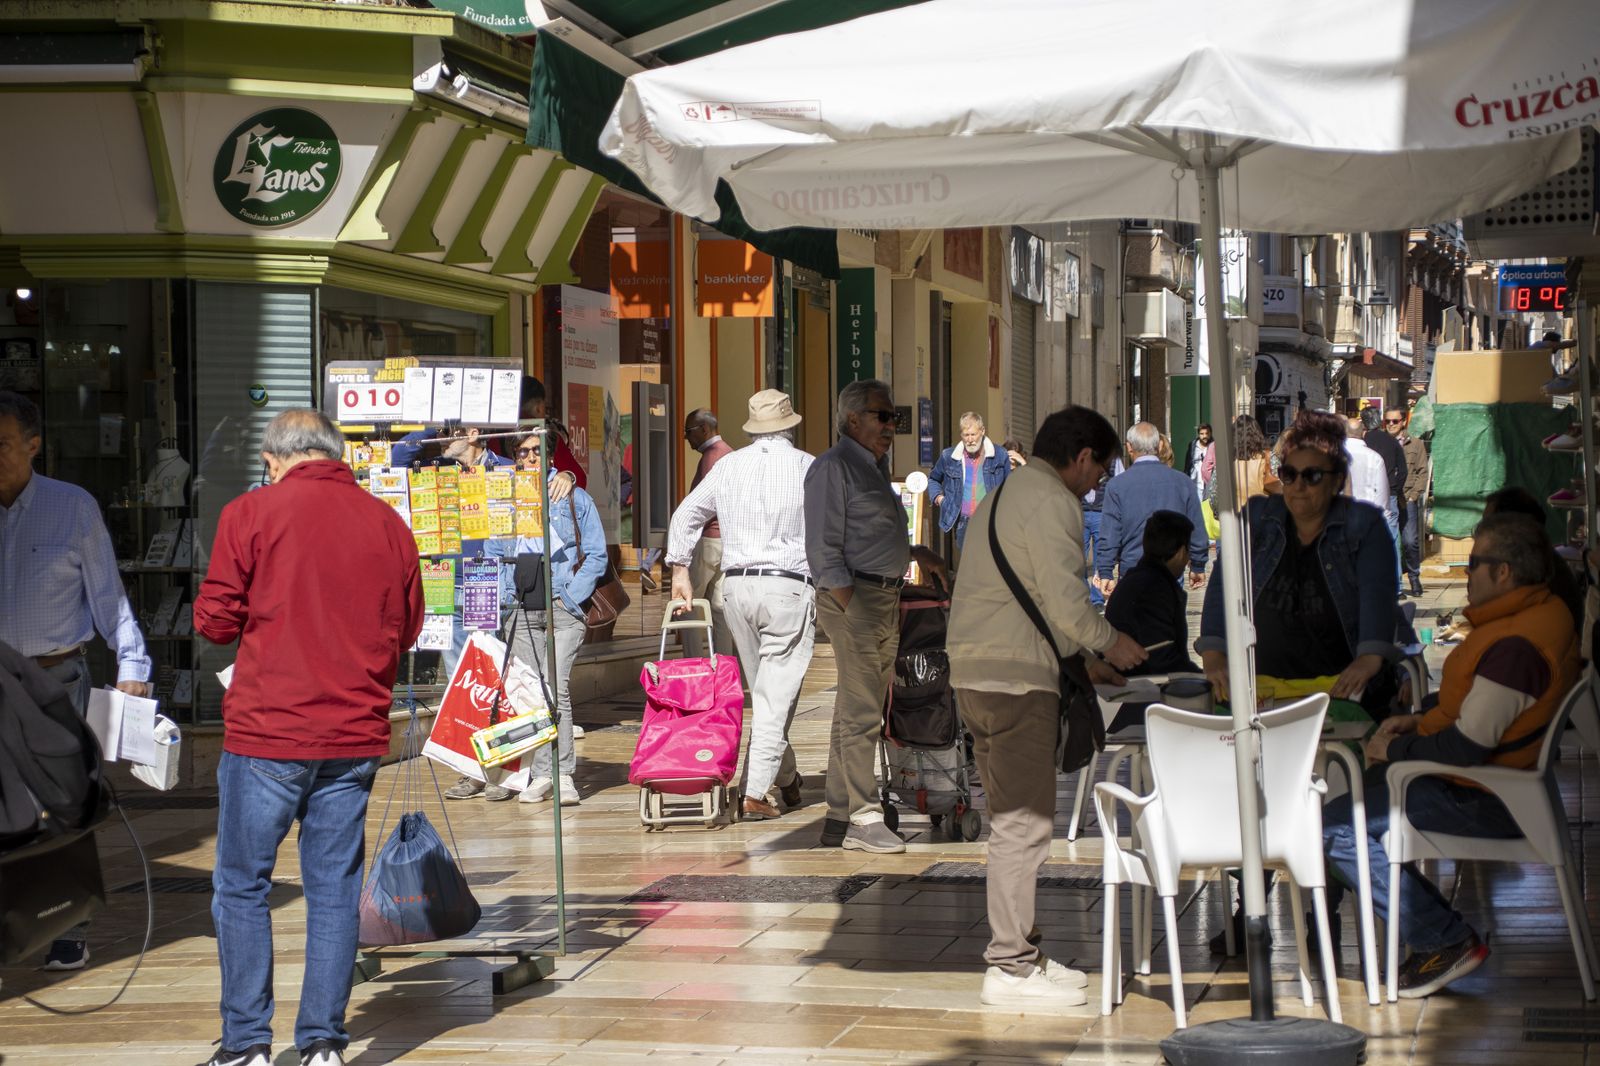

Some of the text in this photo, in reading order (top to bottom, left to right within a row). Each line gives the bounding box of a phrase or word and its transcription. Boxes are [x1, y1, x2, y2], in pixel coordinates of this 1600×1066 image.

[462, 5, 517, 26] Fundada
[292, 140, 332, 156] Tiendas
[239, 207, 296, 222] Fundada en 1915
[1501, 270, 1533, 281] óptica
[1509, 287, 1531, 310] 18
[1184, 311, 1194, 369] Tupperware
[329, 374, 370, 383] BOTE DE
[461, 502, 480, 511] x10
